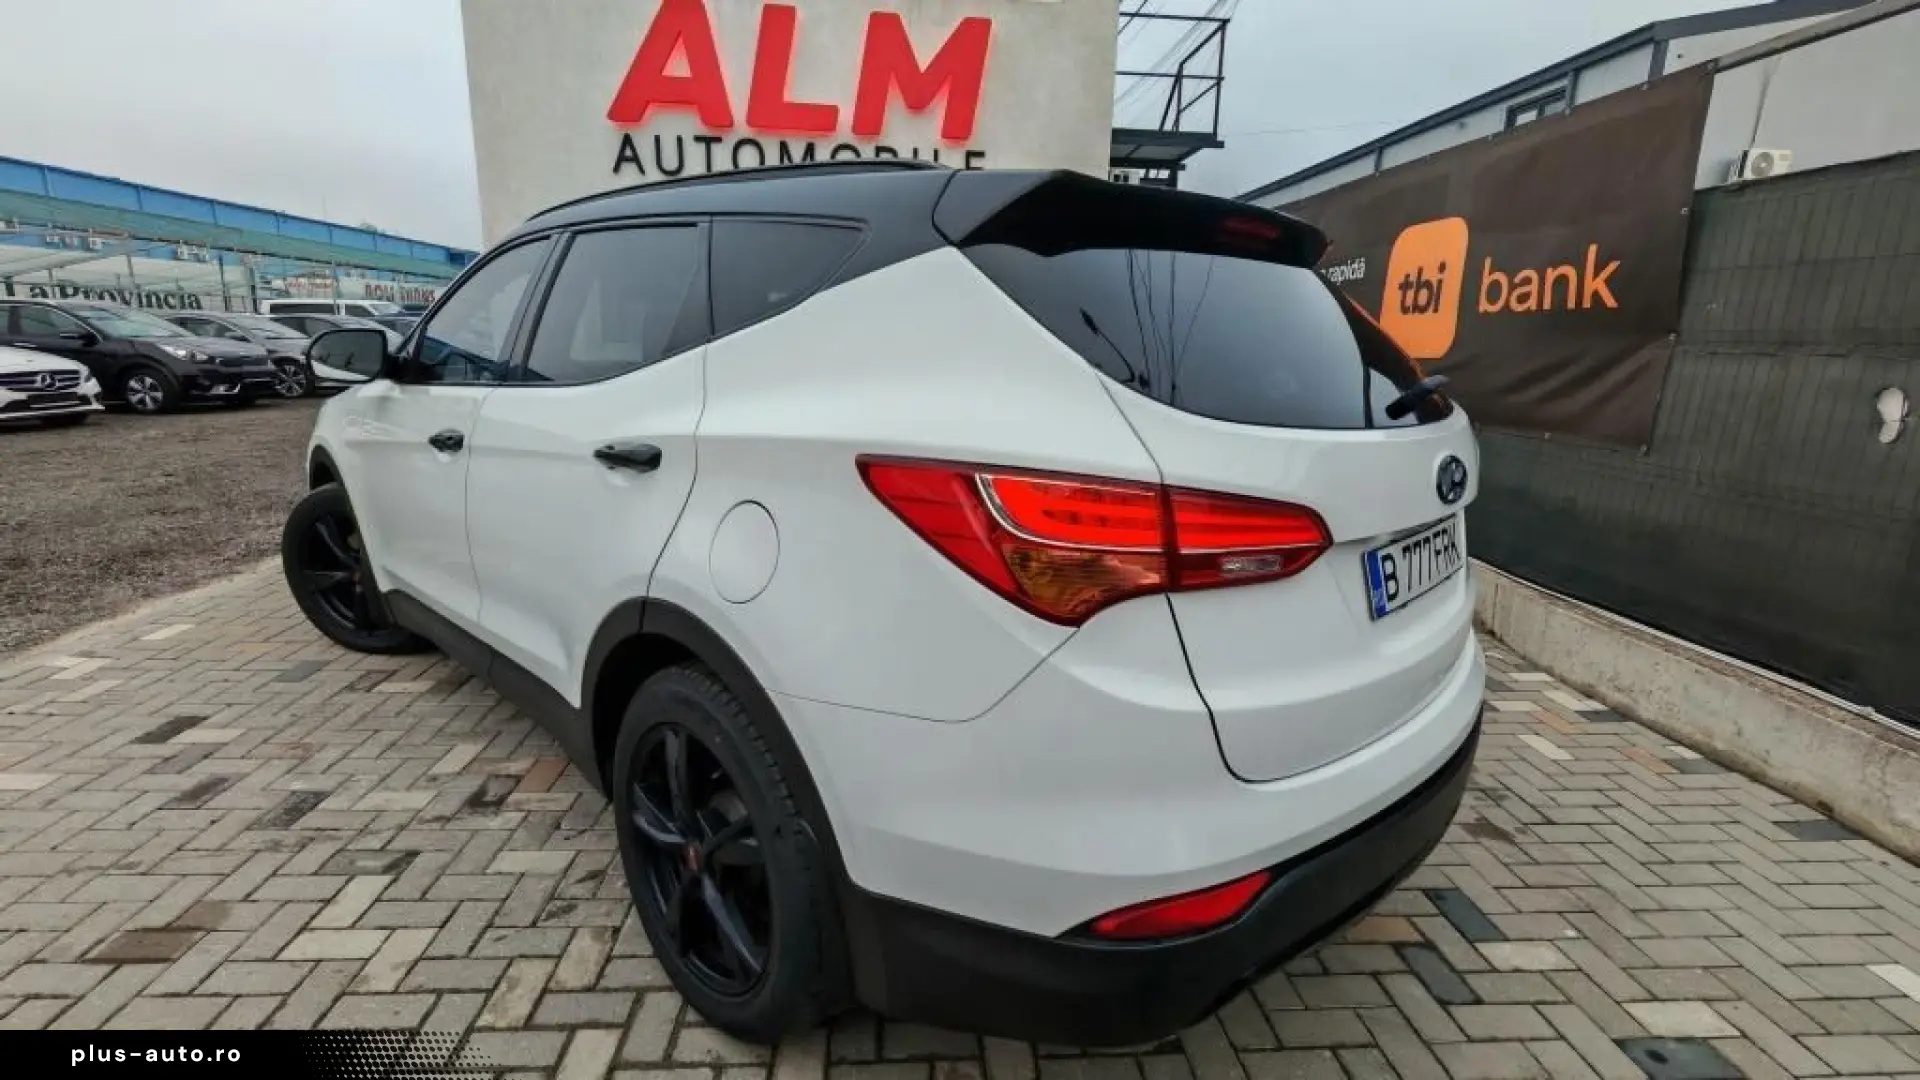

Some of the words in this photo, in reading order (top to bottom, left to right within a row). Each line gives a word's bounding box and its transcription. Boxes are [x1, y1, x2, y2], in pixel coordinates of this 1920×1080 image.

[607, 0, 993, 140] ALM
[1397, 261, 1447, 316] tbi
[1478, 243, 1621, 314] bank
[1381, 552, 1400, 602] B
